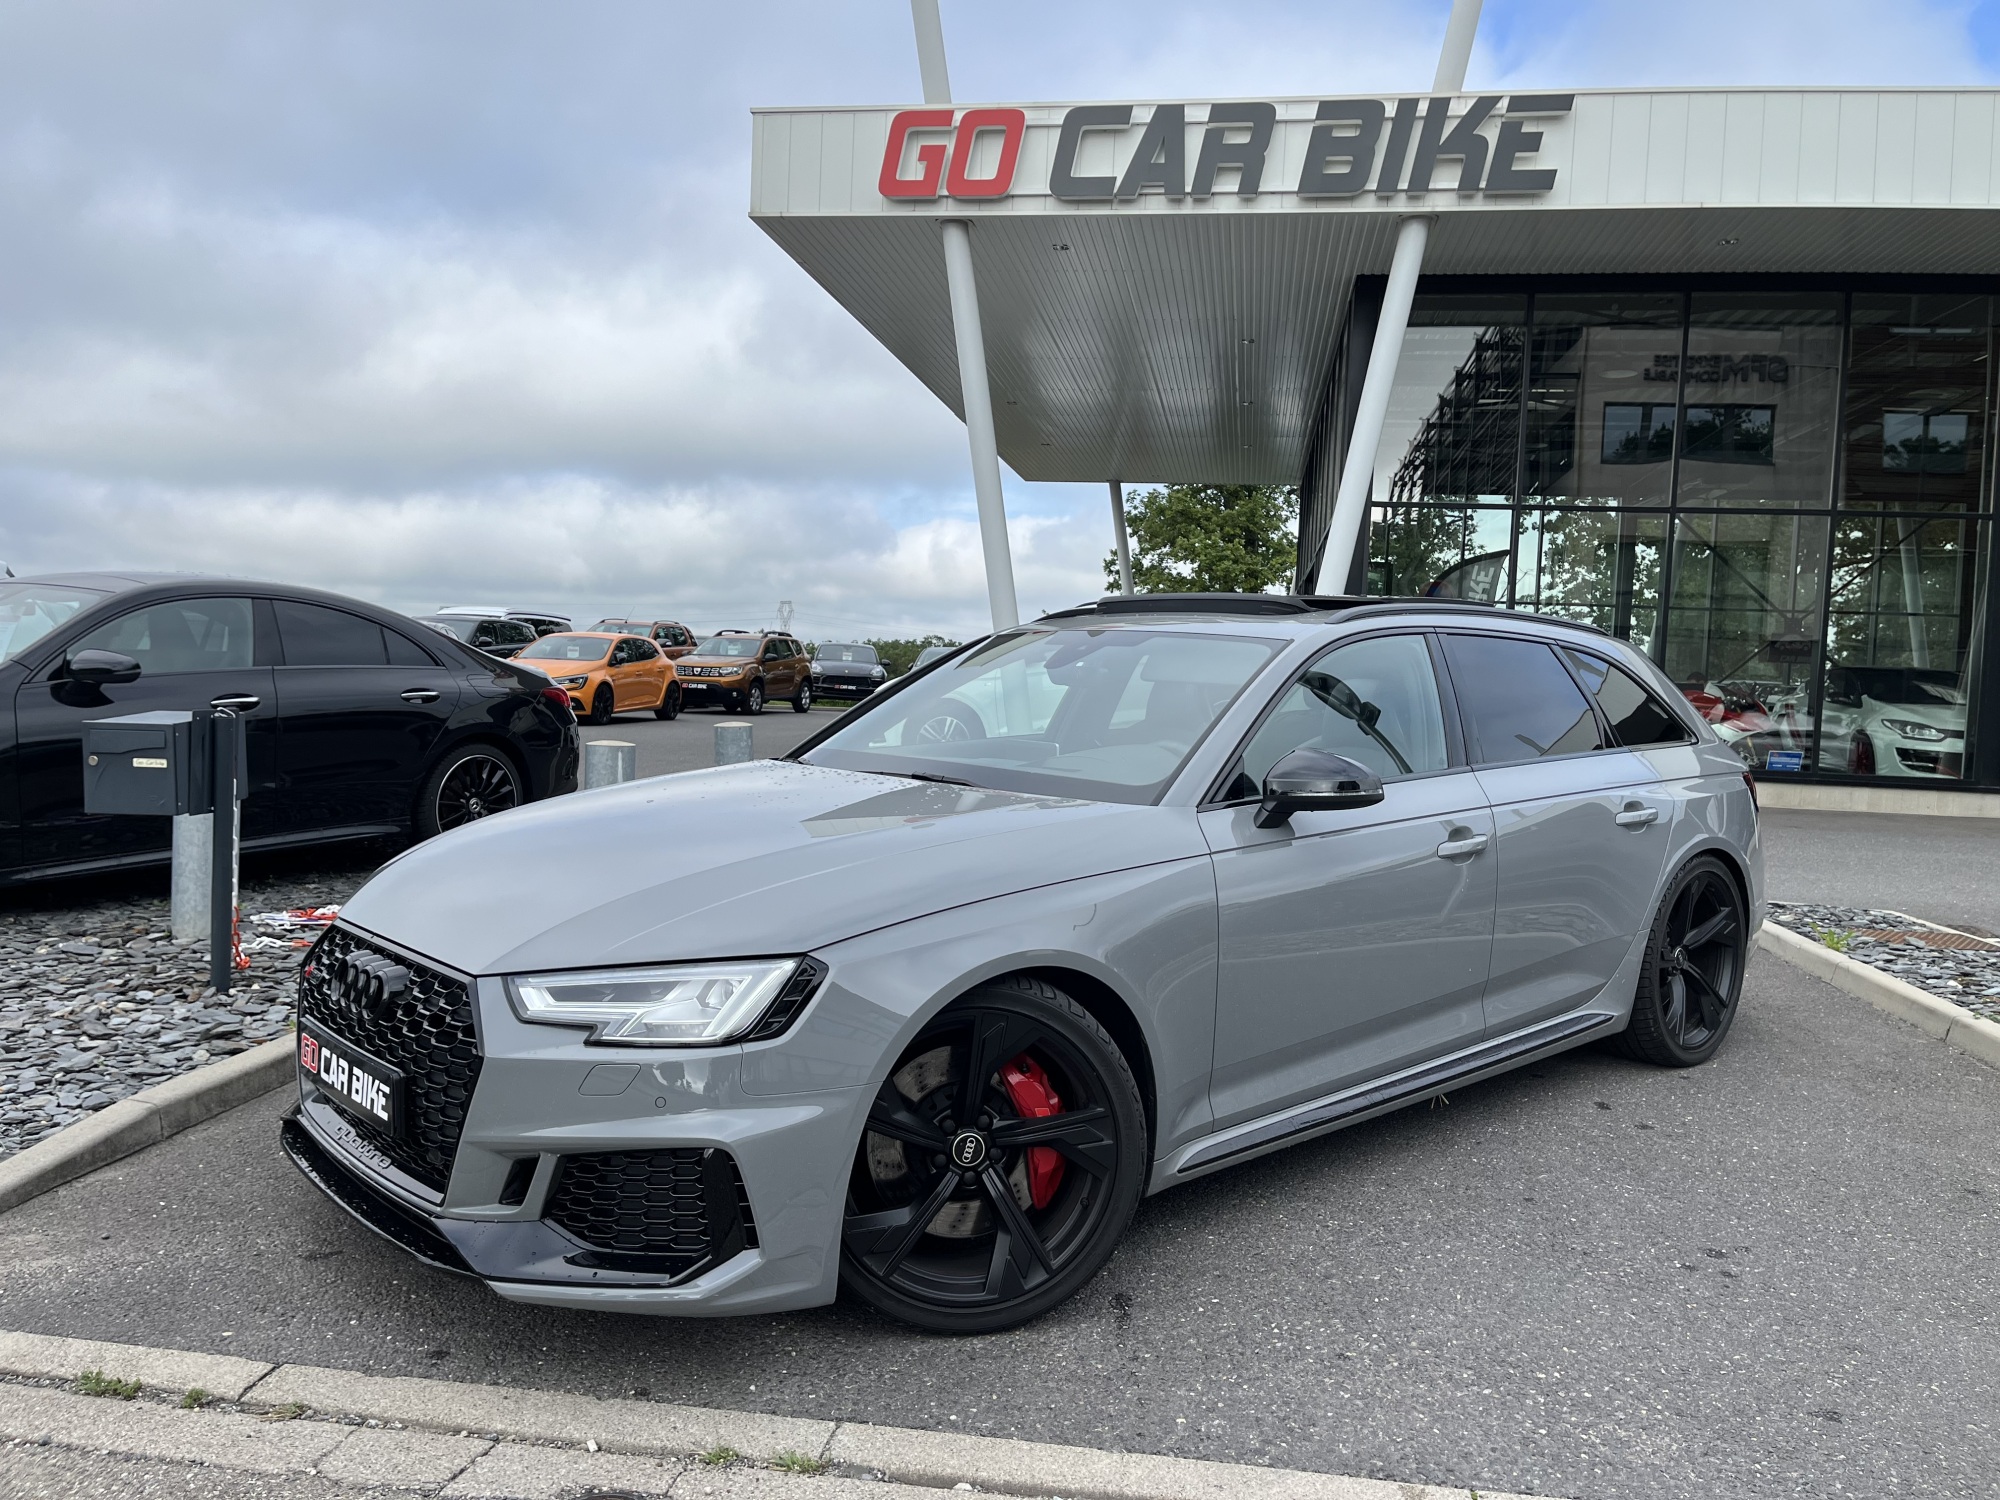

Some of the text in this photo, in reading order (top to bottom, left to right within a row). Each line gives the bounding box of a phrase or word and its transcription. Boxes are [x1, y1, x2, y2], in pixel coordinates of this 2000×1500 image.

[877, 94, 1576, 199] GO CAR BIKE
[300, 1032, 391, 1121] GO CAR BIKE
[334, 1125, 392, 1169] quattro
